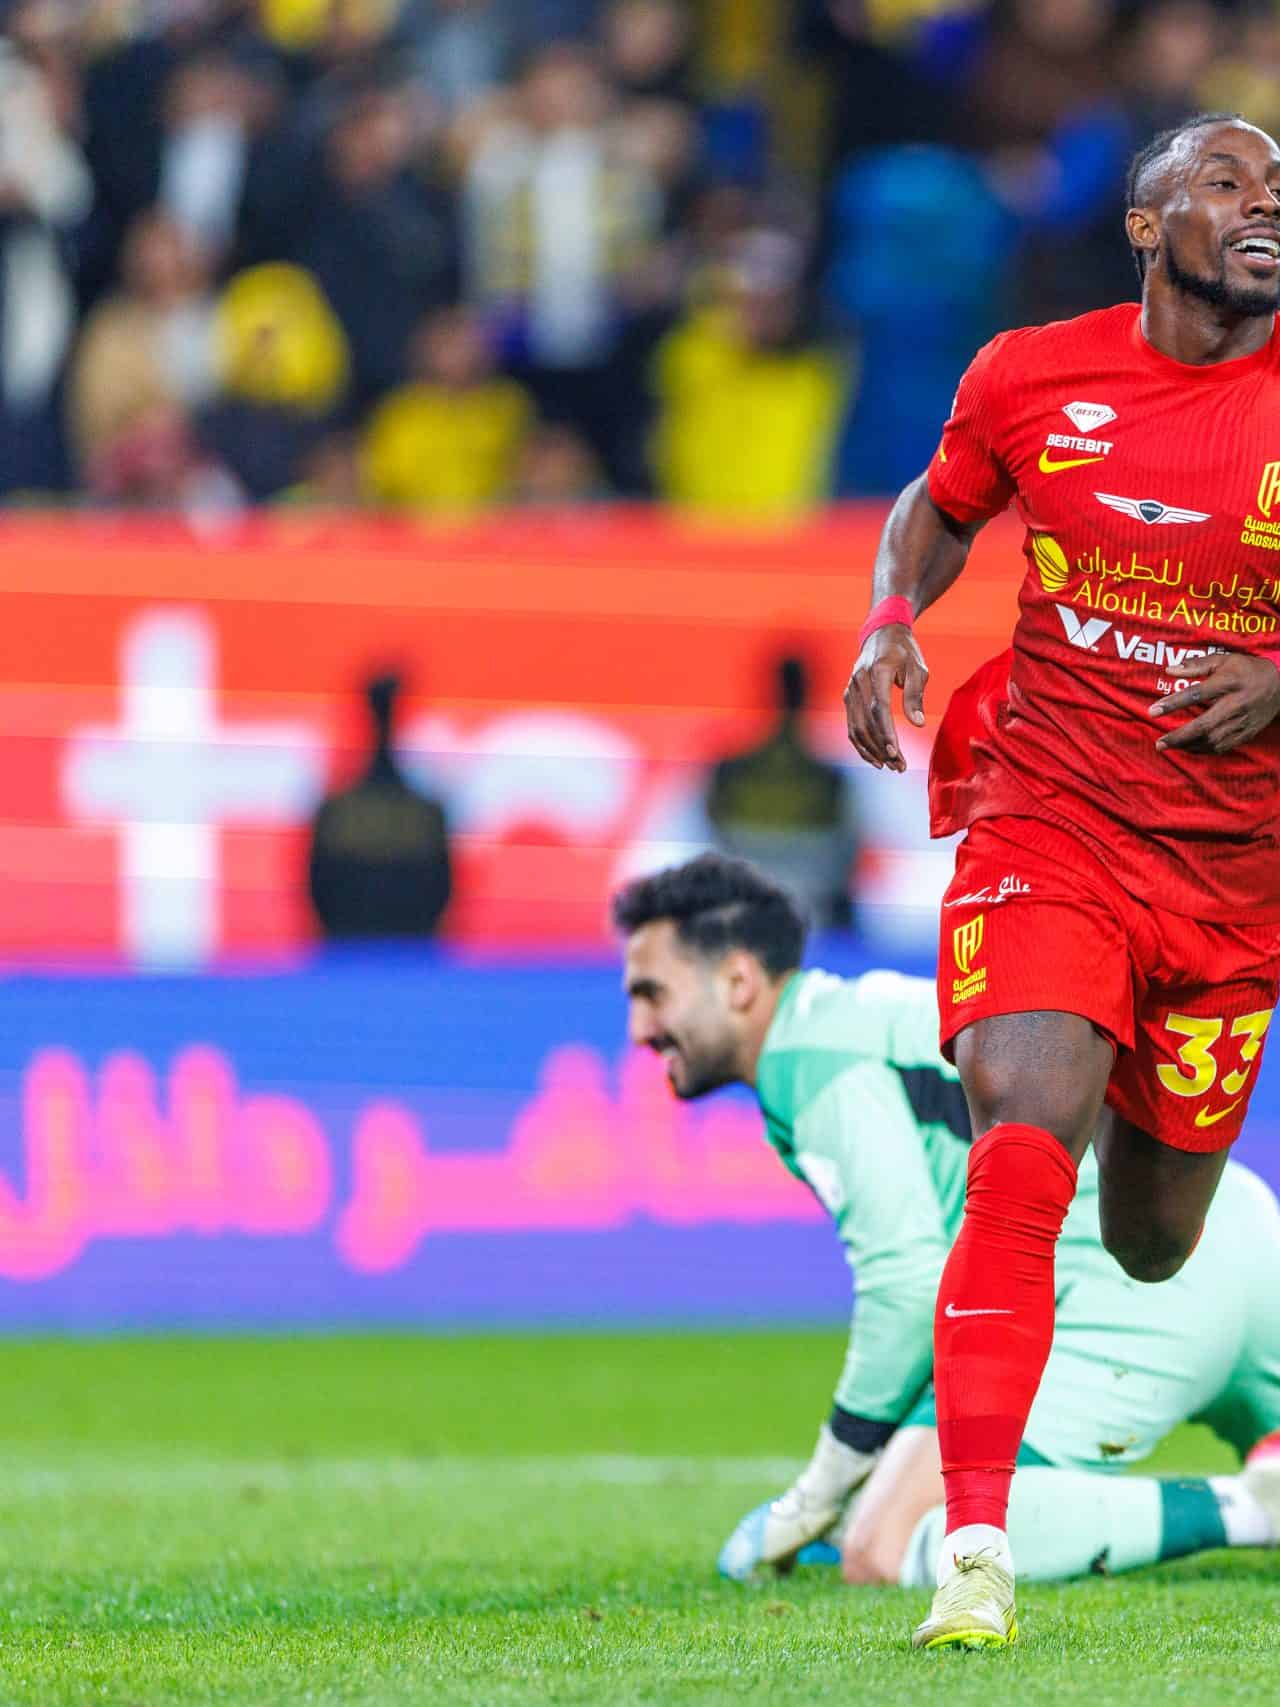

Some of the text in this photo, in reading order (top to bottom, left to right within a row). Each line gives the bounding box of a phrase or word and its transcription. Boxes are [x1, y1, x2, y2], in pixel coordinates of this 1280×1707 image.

[1046, 433, 1114, 455] BESTEBIT
[1076, 546, 1184, 586] للطيران
[1072, 579, 1277, 633] Aloula Aviation
[1156, 677, 1172, 695] by
[1156, 1008, 1274, 1097] 33
